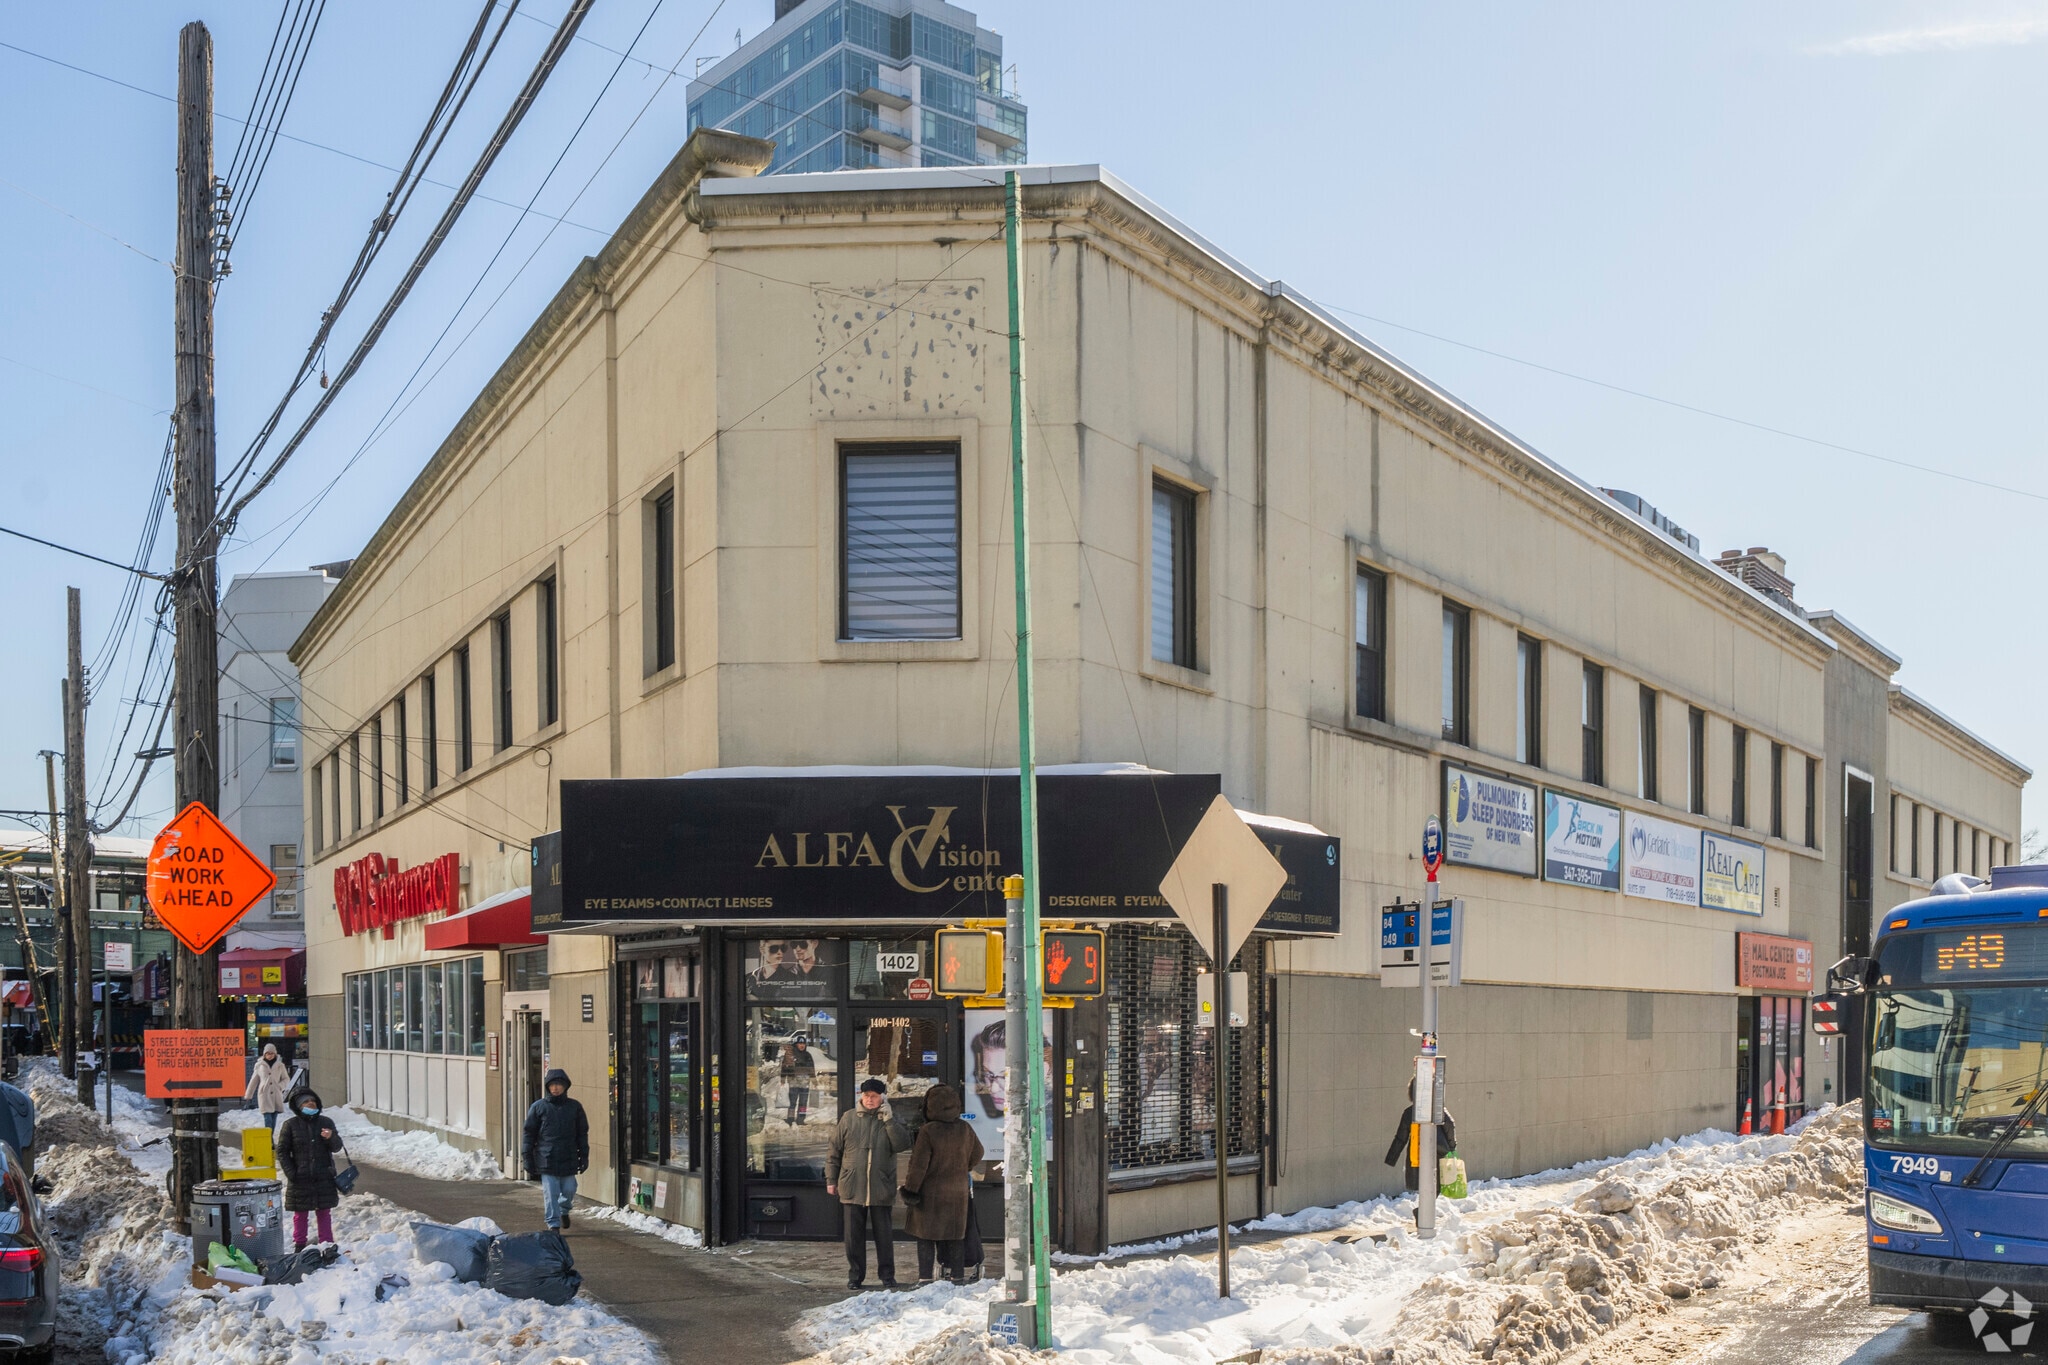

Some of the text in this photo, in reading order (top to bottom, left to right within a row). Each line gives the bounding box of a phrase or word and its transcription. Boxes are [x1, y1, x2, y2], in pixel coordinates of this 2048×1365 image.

[1477, 781, 1527, 811] PULMONARY &
[1472, 801, 1534, 833] SLEEP DISORDERS
[1486, 827, 1493, 840] OF
[1495, 829, 1506, 842] NEW
[1507, 830, 1521, 846] YORK
[1578, 820, 1603, 836] BACK IN
[754, 805, 1001, 872] ALFA Vision
[1575, 832, 1602, 848] MOTION
[1647, 833, 1670, 856] Geriatric
[169, 845, 224, 864] ROAD
[889, 825, 1006, 893] Cente
[170, 867, 225, 885] WORK
[550, 862, 561, 887] AL
[1563, 865, 1602, 885] 347-395-1717
[1707, 840, 1733, 877] REAL
[1734, 860, 1760, 895] CARE
[163, 889, 233, 907] AHEAD
[380, 853, 459, 940] pharmacy
[584, 898, 608, 909] EYE
[725, 897, 774, 908] LENSES
[1049, 895, 1170, 906] DESIGNER EYEWE
[1383, 915, 1415, 928] B4 5
[1383, 933, 1397, 946] B49
[1752, 944, 1768, 961] MAIL
[1770, 945, 1794, 964] CENTER
[1938, 934, 2004, 970] B49
[880, 955, 915, 970] 1402
[1084, 945, 1097, 985] 9
[1752, 965, 1776, 979] POSTMAN
[1777, 967, 1786, 980] JOE
[258, 1008, 308, 1017] MONEY TRANSFE
[870, 1017, 910, 1028] 1400-1402
[151, 1037, 178, 1047] STREET
[144, 1047, 244, 1058] TO SHEEPSHEAD BAY ROAD
[157, 1057, 229, 1068] THRU E16TH STREET
[1890, 1156, 1939, 1175] 7949
[1003, 1314, 1017, 1326] LAWYE
